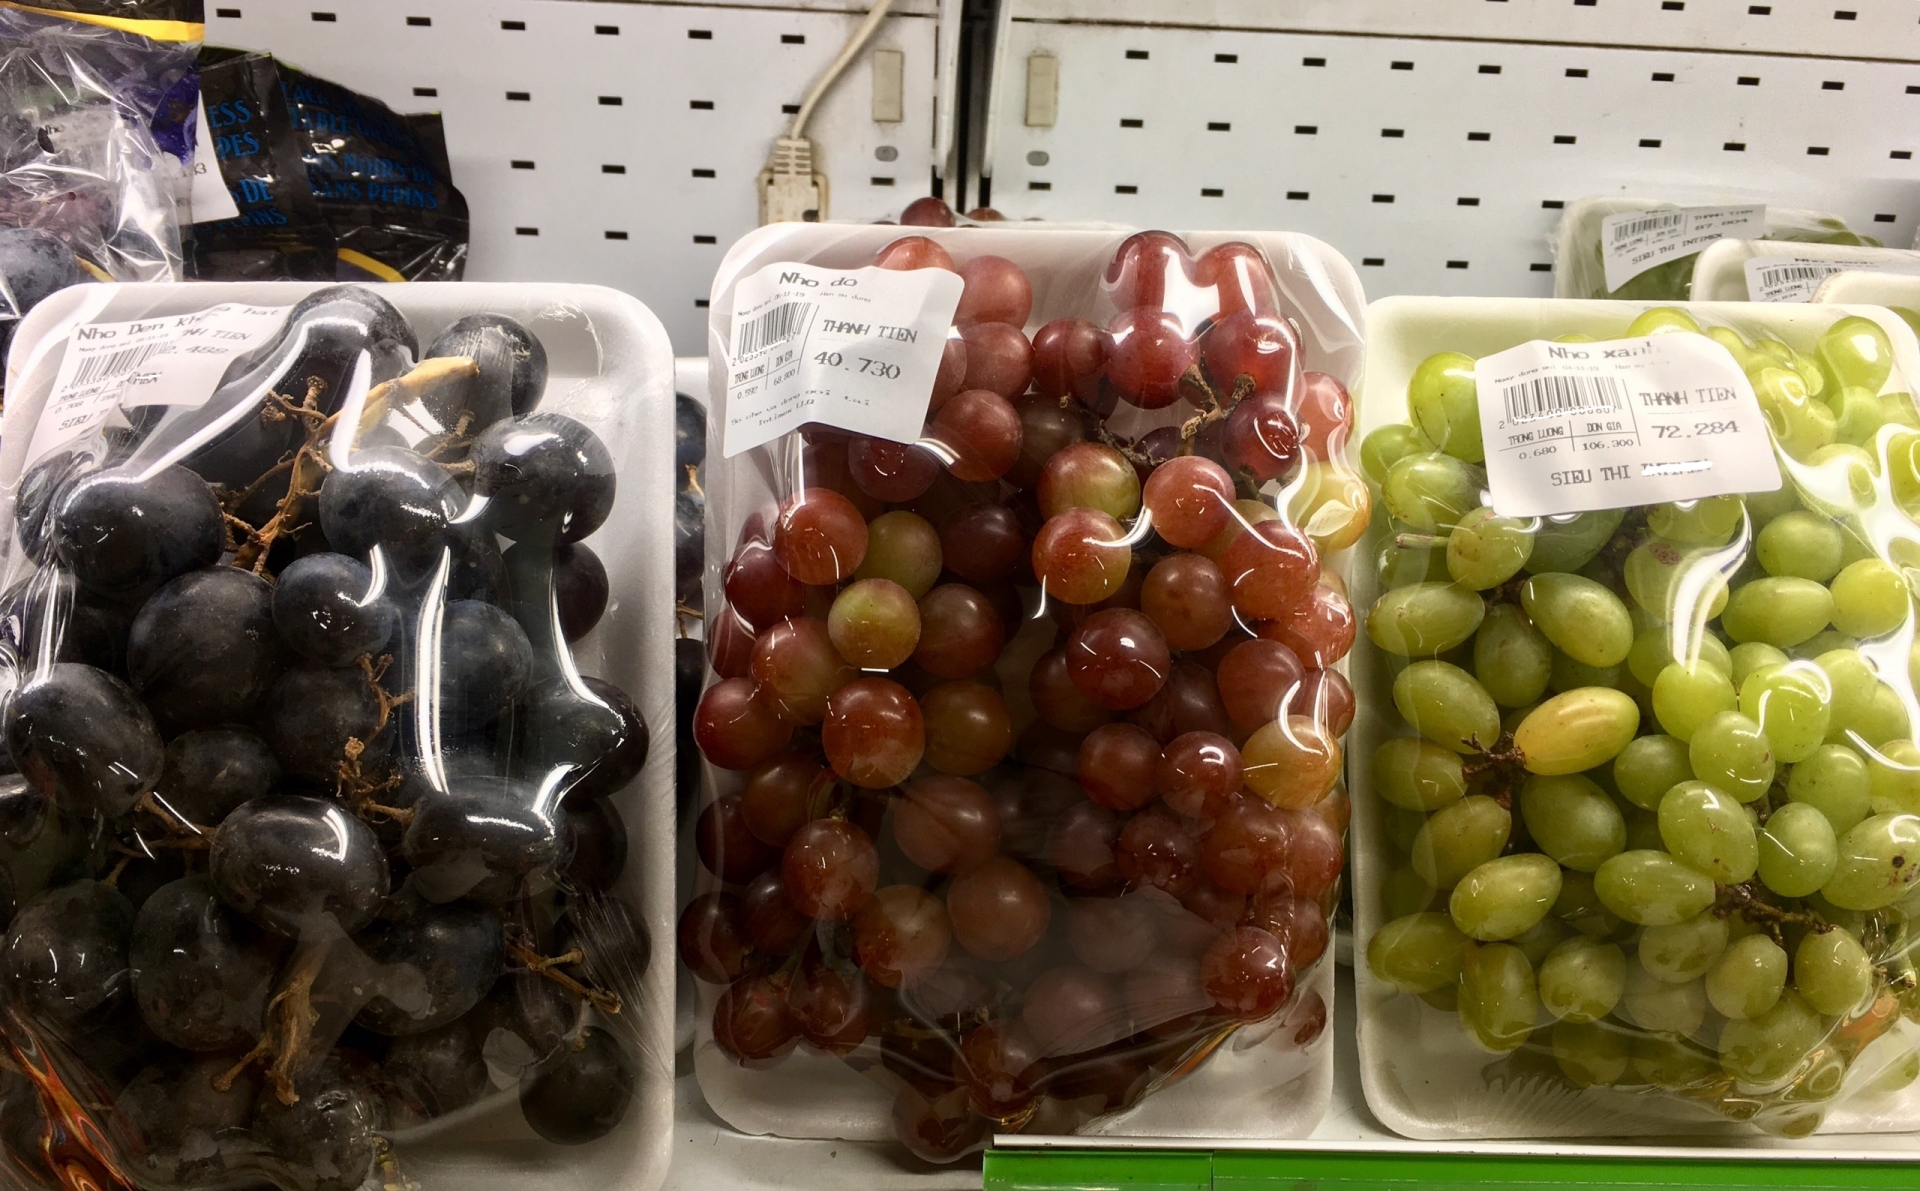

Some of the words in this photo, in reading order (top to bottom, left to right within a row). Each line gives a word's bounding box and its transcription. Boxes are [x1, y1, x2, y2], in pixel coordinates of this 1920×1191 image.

[1658, 243, 1676, 254] THI
[1682, 232, 1723, 247] INTIMEX
[779, 271, 820, 288] Nho
[830, 276, 859, 287] do
[77, 327, 117, 341] Nho
[127, 322, 165, 336] Den
[211, 329, 253, 341] TIEN
[822, 318, 871, 336] THANH
[877, 325, 919, 344] TIEN
[1547, 345, 1590, 360] Nho
[1602, 340, 1662, 359] xanh
[813, 351, 902, 380] 40.730
[1639, 390, 1689, 406] THANH
[1695, 386, 1738, 403] TIEN
[58, 412, 94, 431] SIEU
[1498, 420, 1506, 430] 2
[1651, 419, 1742, 439] 72.284
[1508, 431, 1535, 446] TRONG
[1537, 425, 1564, 440] LUONG
[1587, 422, 1604, 434] DON
[1606, 420, 1623, 431] GIA
[1518, 445, 1558, 460] 0.680
[1582, 438, 1635, 451] 106.300
[1550, 468, 1593, 487] SIEU
[1600, 464, 1632, 482] THI
